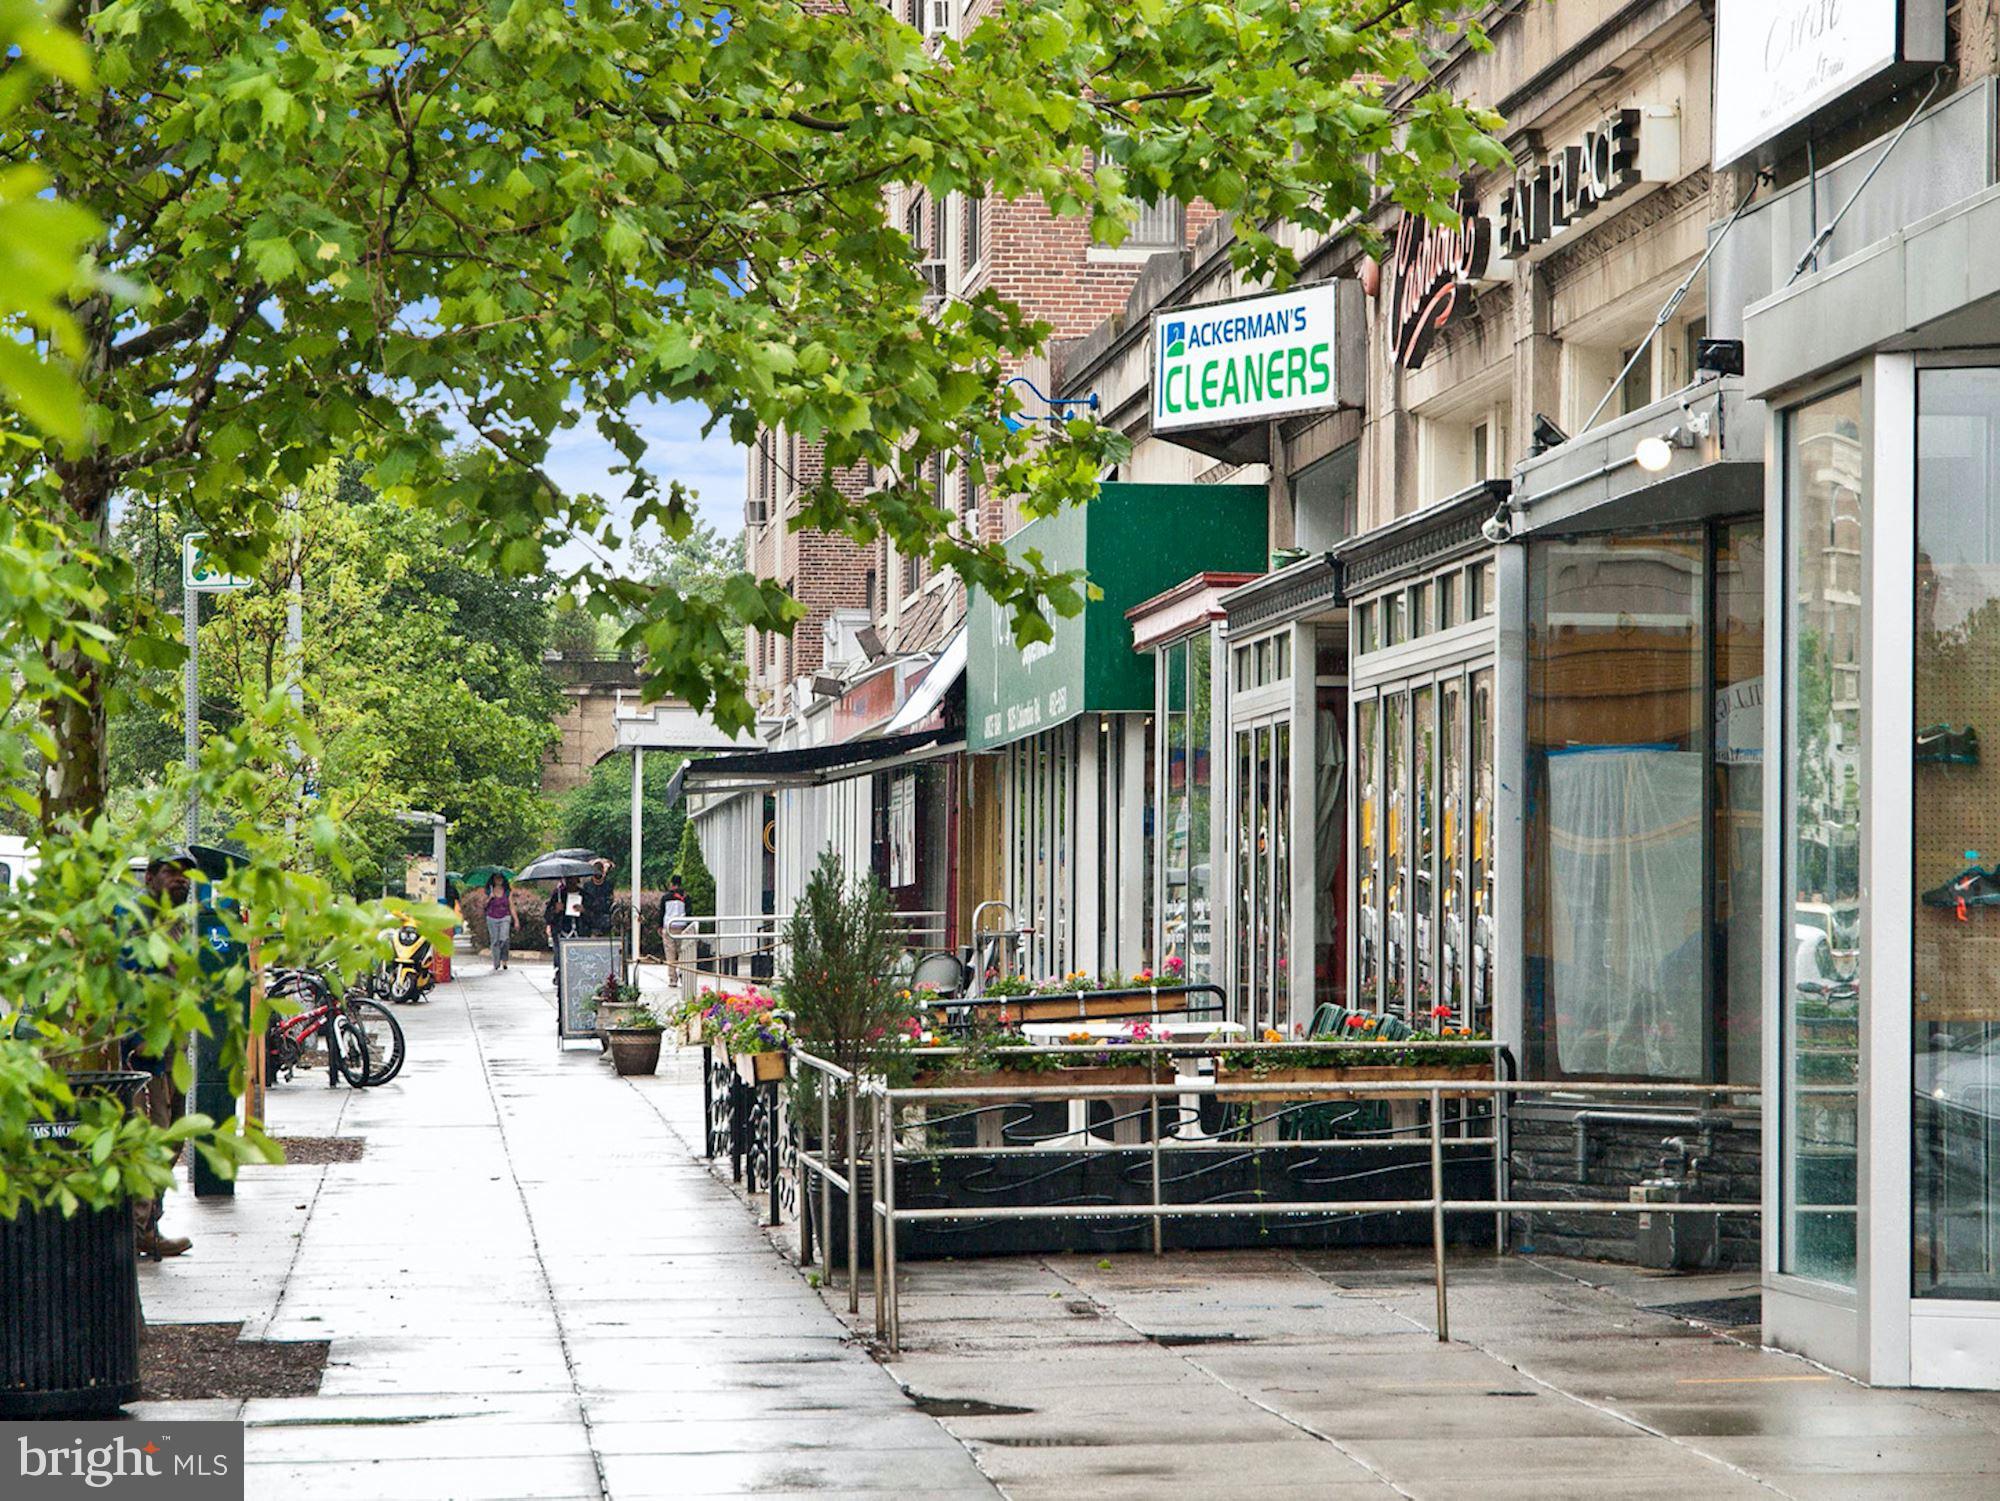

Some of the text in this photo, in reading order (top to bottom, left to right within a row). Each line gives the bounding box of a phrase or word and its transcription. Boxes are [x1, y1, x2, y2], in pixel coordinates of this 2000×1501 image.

[1500, 165, 1550, 258] EAT
[1551, 109, 1641, 226] PLACE
[1188, 306, 1307, 349] ACKERMAN'S
[1165, 342, 1330, 414] CLEANERS
